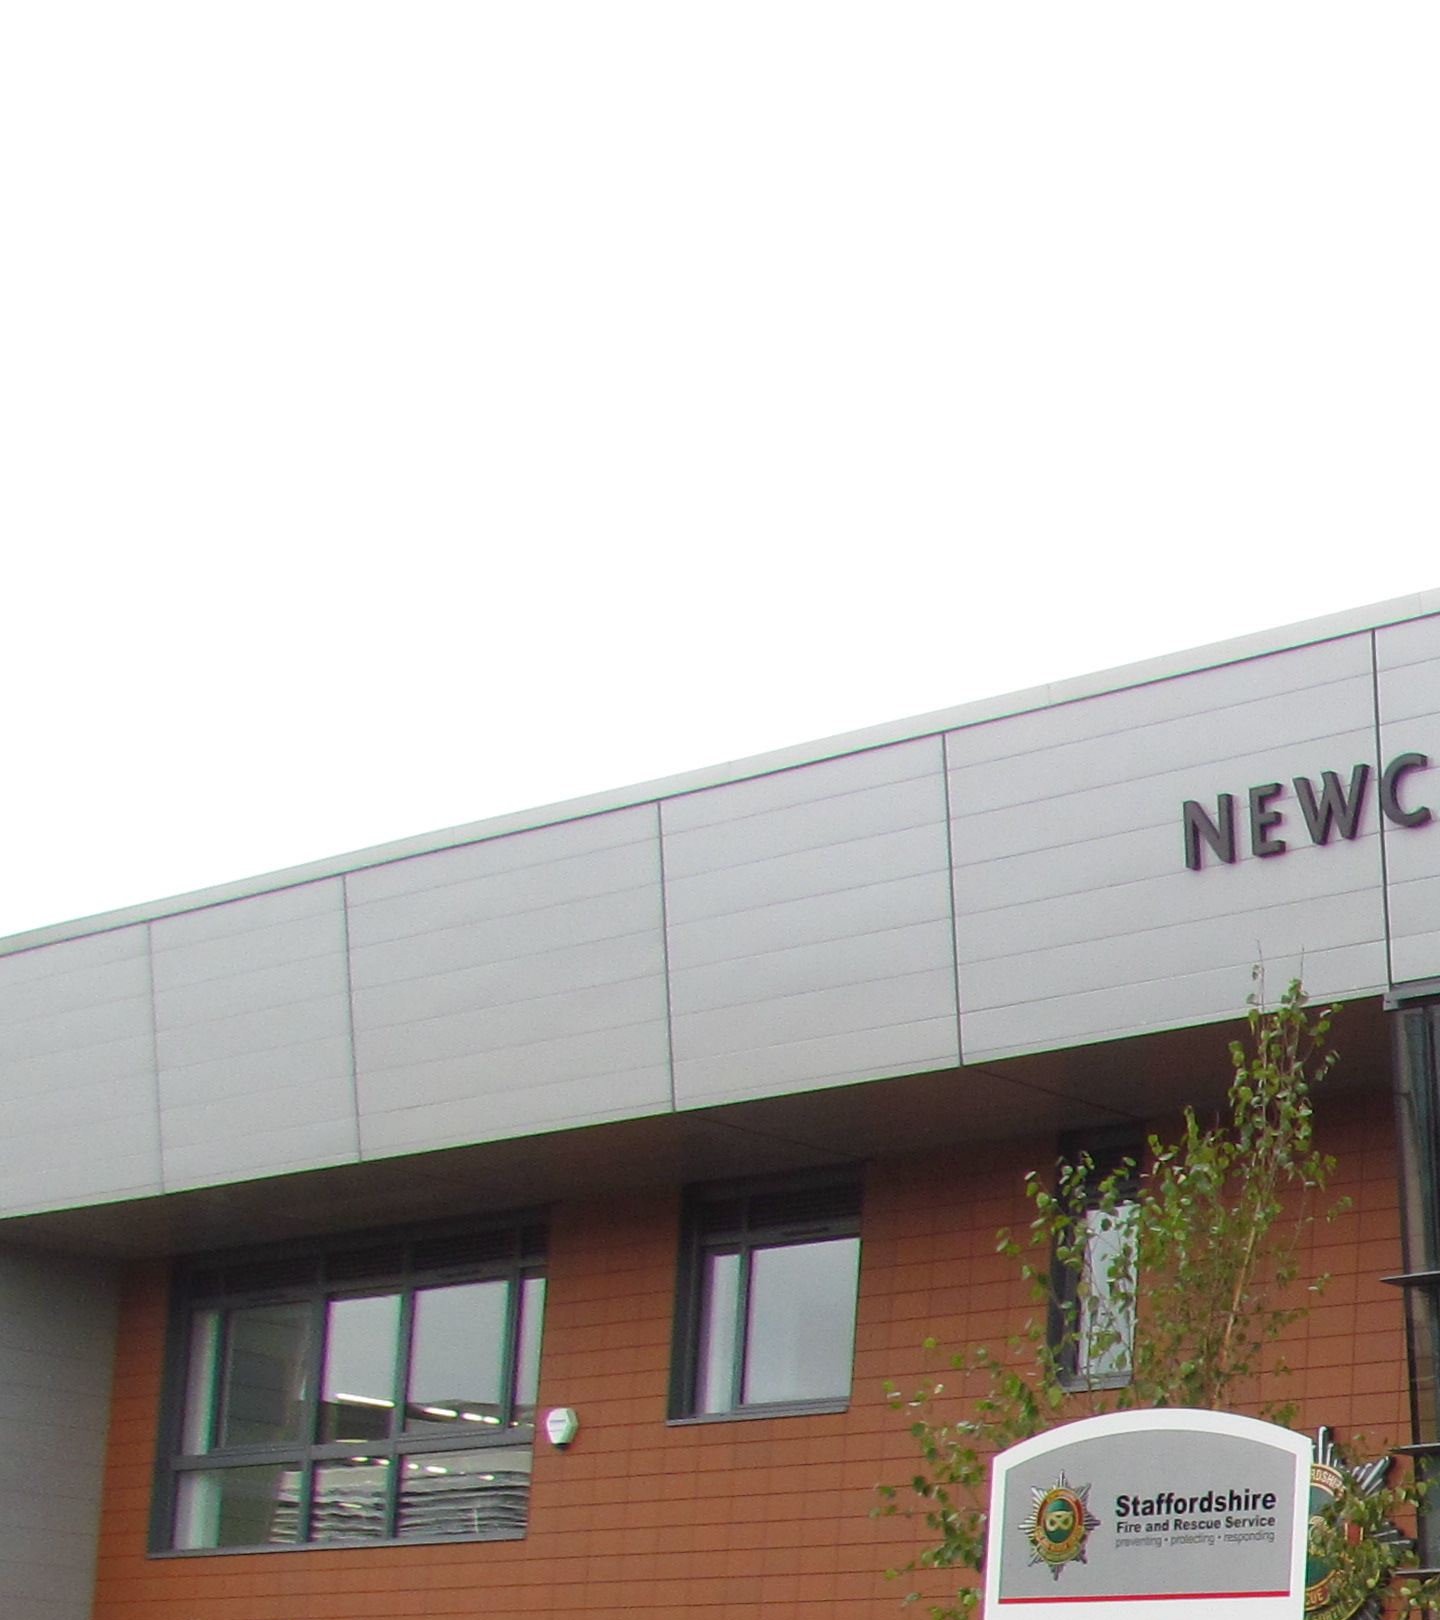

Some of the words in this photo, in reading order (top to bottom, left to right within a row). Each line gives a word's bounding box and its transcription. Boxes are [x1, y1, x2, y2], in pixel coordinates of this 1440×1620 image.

[1115, 1488, 1277, 1518] Staffordshire
[1117, 1520, 1142, 1533] Fire
[1145, 1520, 1170, 1532] and
[1174, 1518, 1221, 1531] Rescue
[1225, 1515, 1276, 1529] Service
[1223, 1530, 1275, 1545] responding
